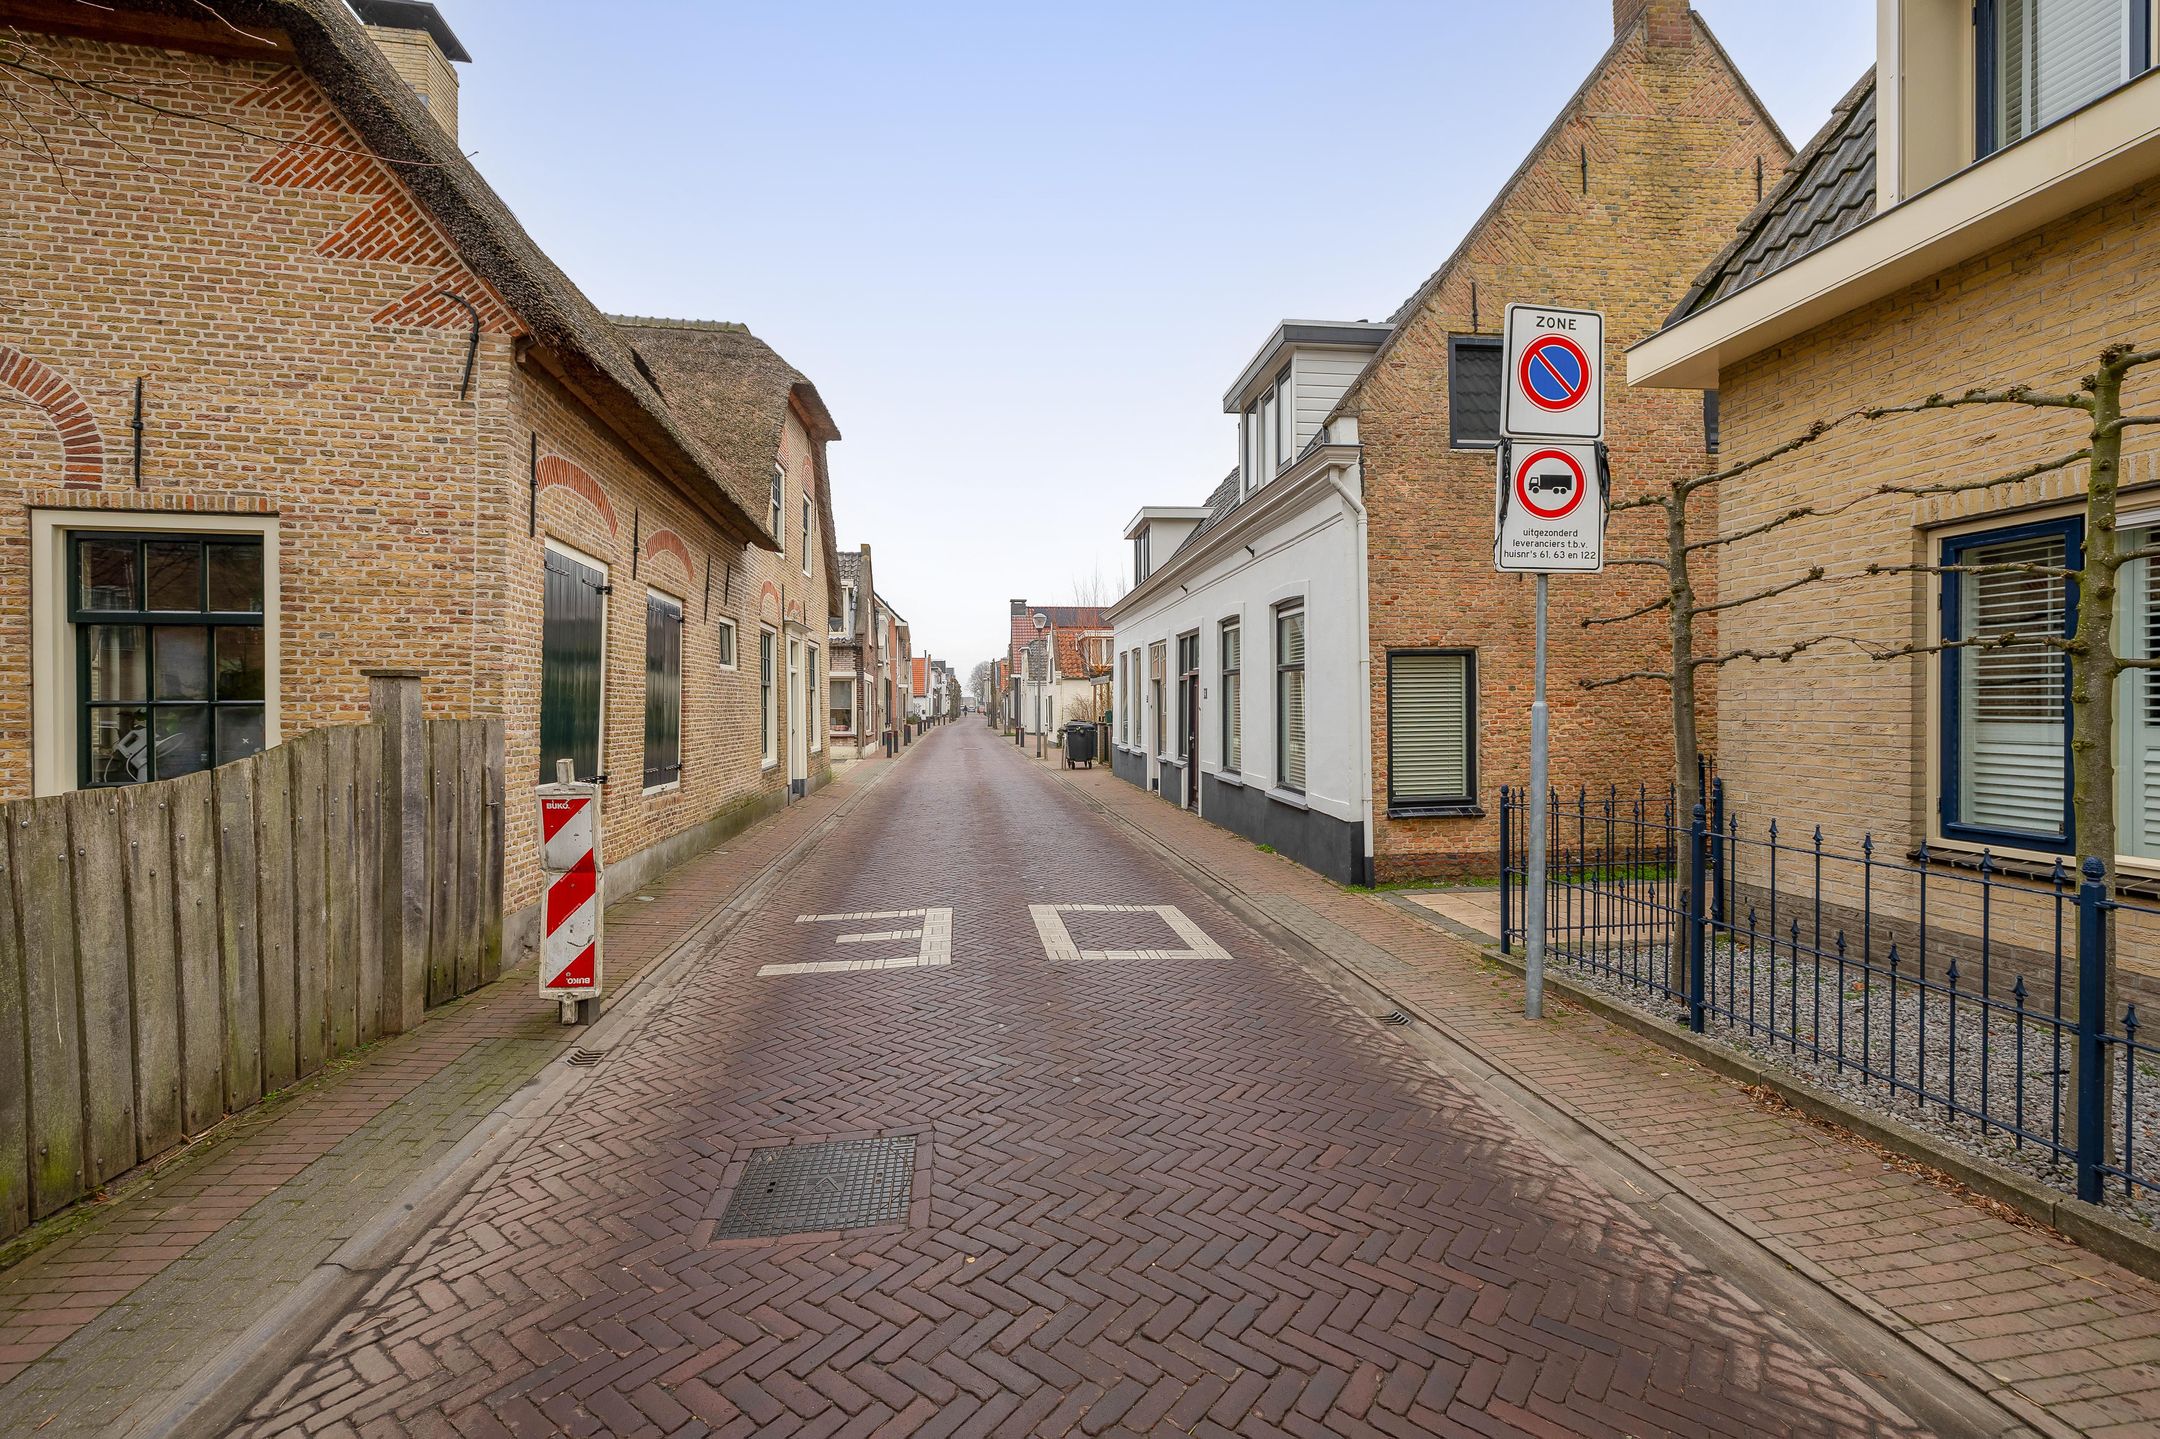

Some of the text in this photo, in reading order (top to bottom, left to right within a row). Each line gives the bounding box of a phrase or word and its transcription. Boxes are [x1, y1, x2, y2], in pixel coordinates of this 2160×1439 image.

[1536, 316, 1577, 331] ZONE
[1523, 528, 1578, 538] uitgezonderd
[1513, 539, 1588, 548] leveranciers t.b.v.
[1504, 550, 1537, 558] huisnr's
[1554, 551, 1566, 559] 63
